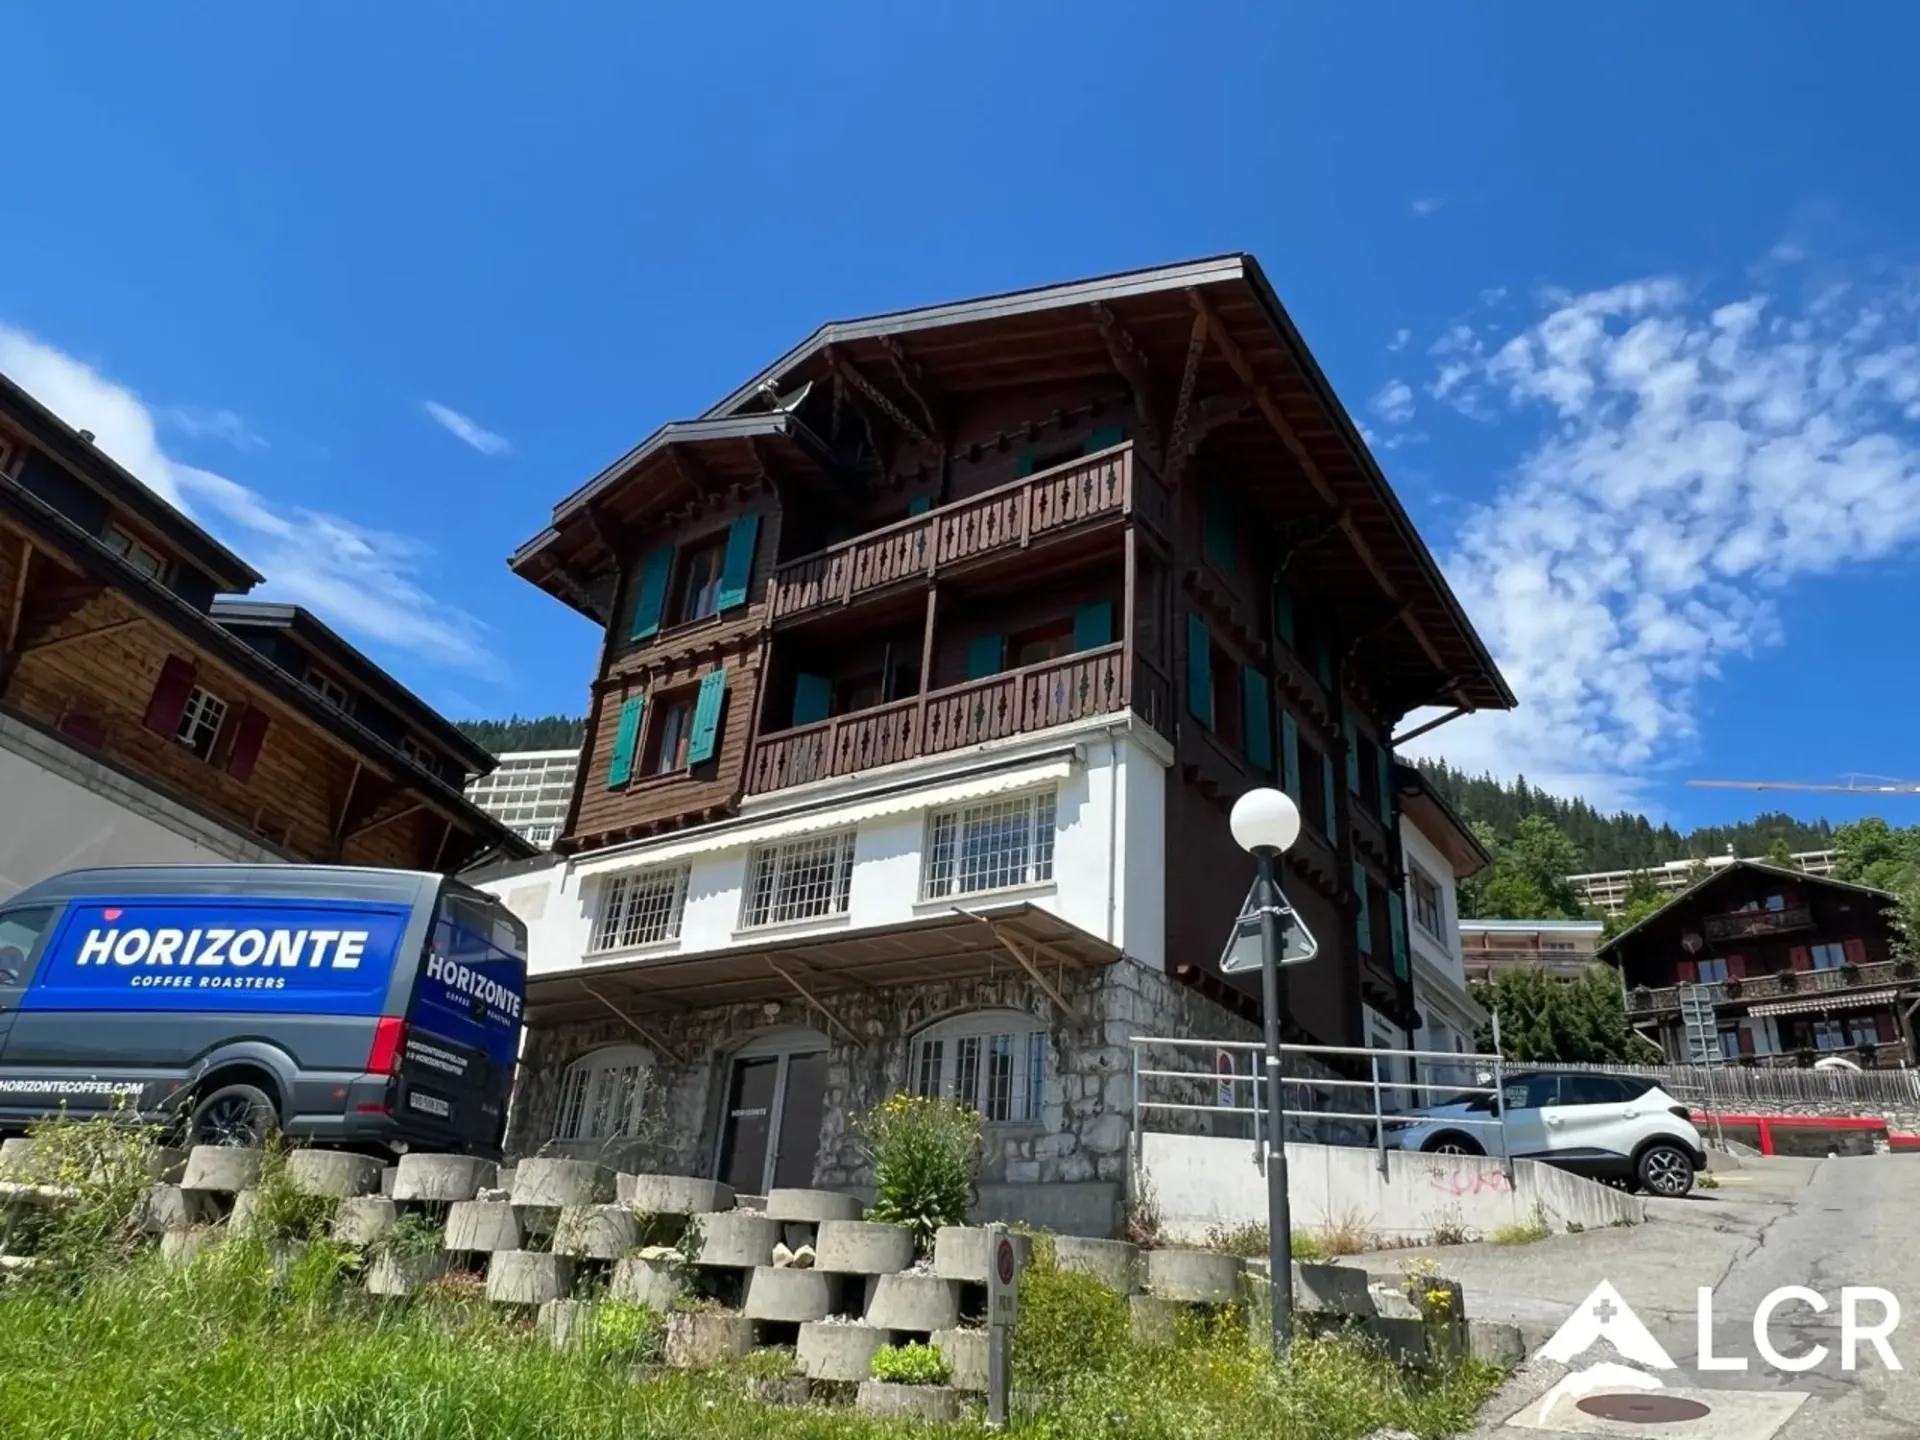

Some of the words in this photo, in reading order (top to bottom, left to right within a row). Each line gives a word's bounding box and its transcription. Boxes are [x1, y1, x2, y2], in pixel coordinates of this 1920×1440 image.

[77, 928, 369, 969] HORIZONTE
[131, 975, 193, 987] COFFEE
[199, 976, 286, 989] ROASTERS
[426, 953, 521, 1018] HORIZONTE
[0, 1079, 145, 1095] HORIZONTECOFFEE.COM
